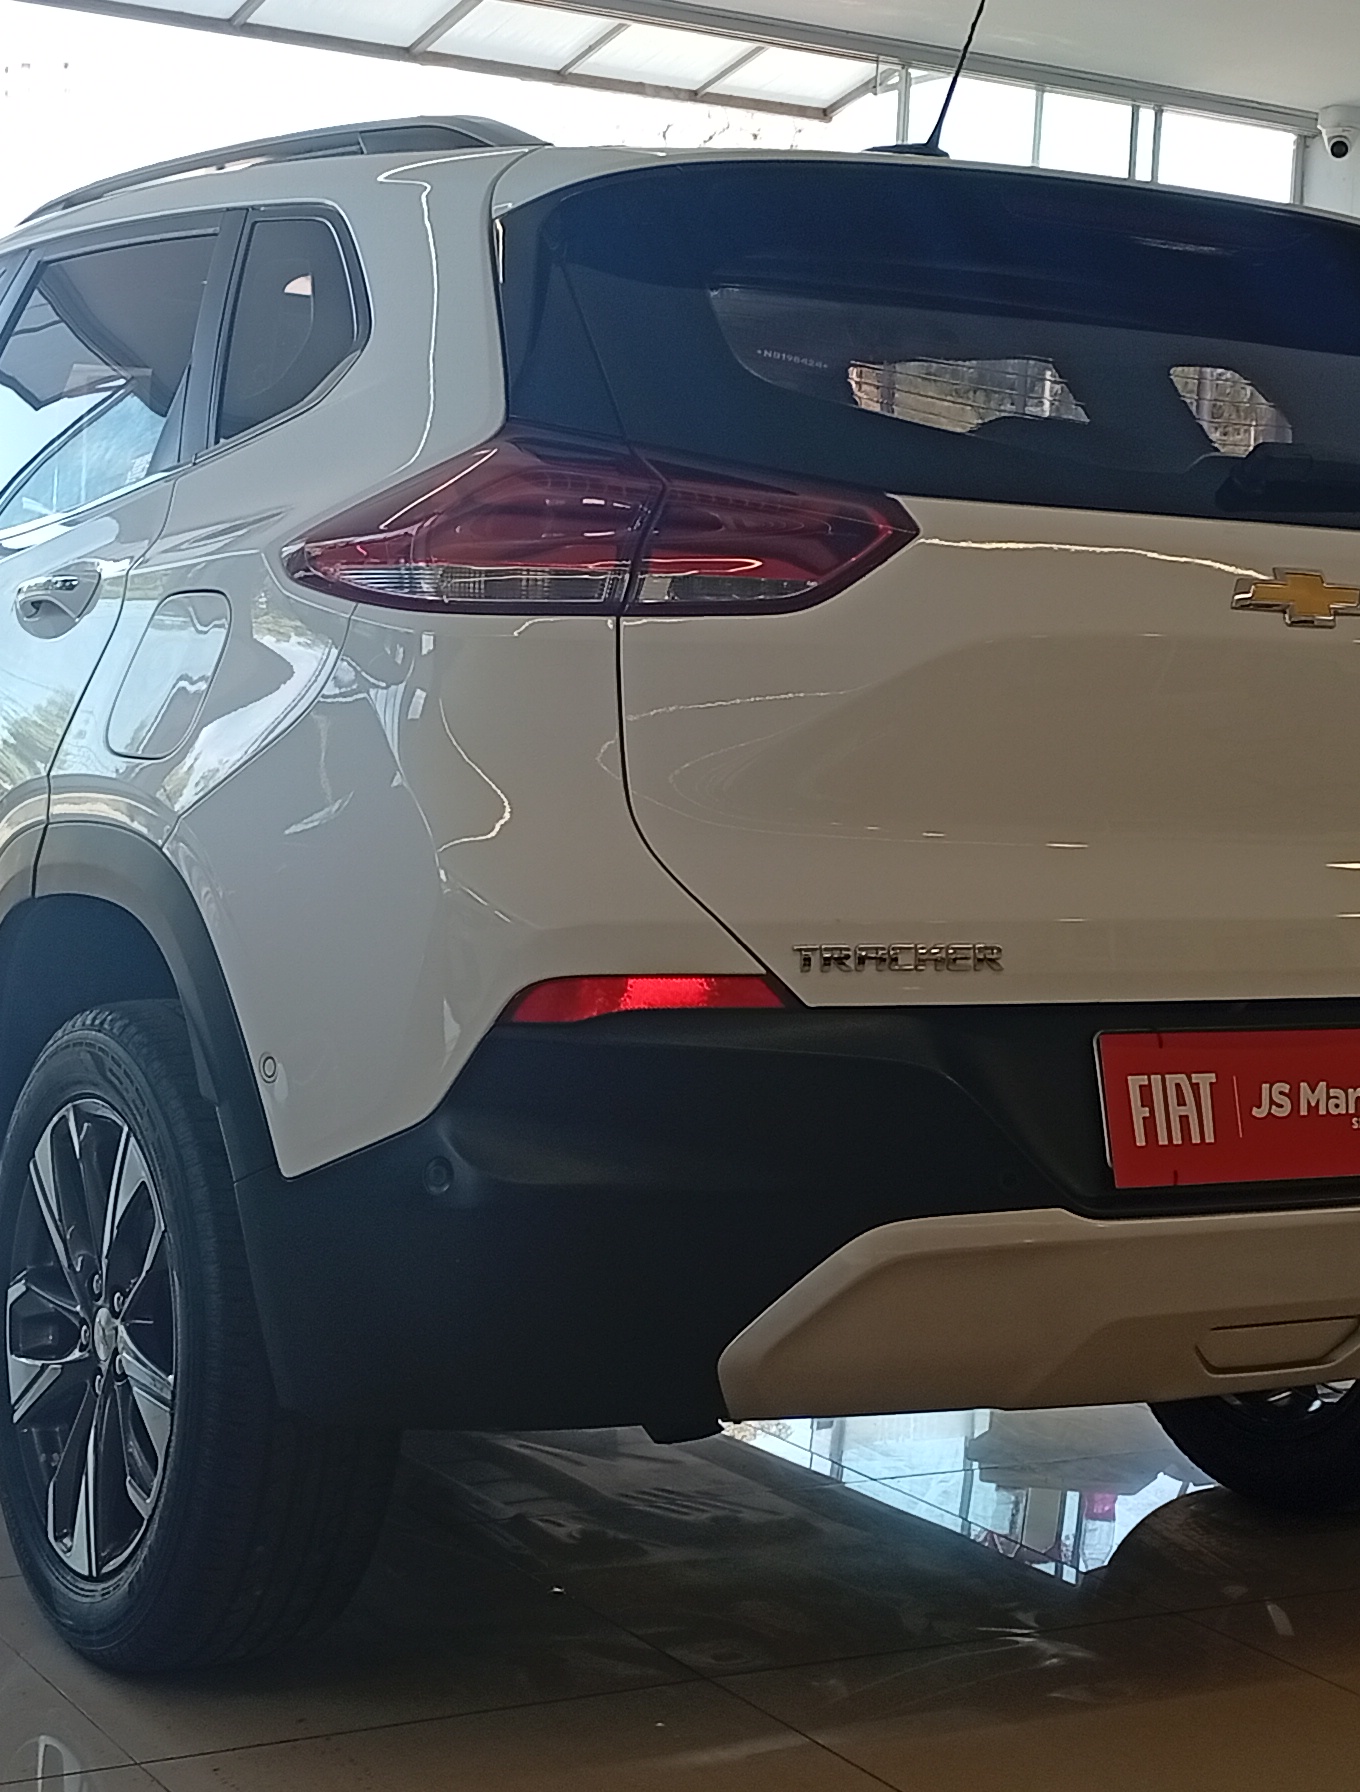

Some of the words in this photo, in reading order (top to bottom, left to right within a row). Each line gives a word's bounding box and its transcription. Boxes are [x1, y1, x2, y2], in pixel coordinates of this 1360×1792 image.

[792, 942, 1004, 973] TRACKER
[1127, 1073, 1217, 1146] FIAT
[1251, 1083, 1292, 1118] JS
